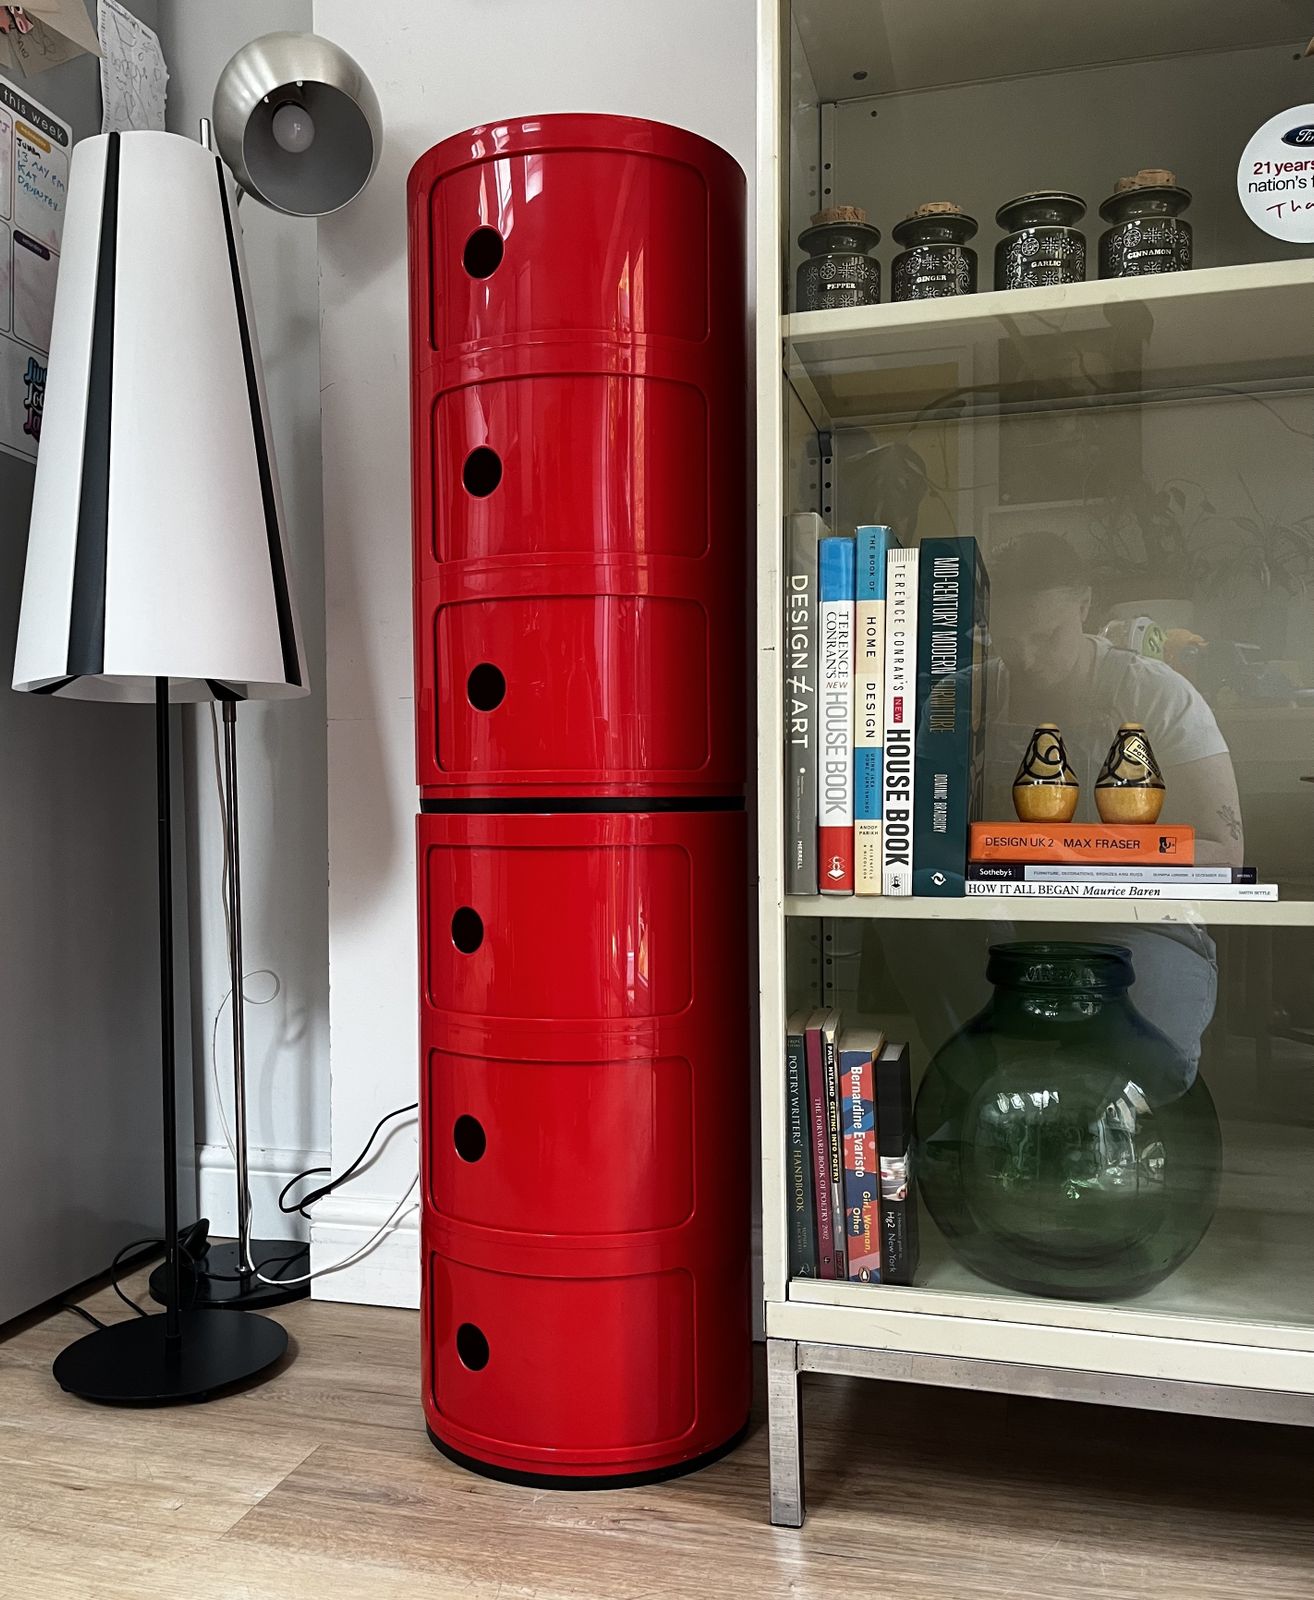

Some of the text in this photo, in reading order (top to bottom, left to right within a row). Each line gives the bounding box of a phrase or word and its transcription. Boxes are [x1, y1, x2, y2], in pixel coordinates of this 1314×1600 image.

[3, 90, 26, 114] this
[32, 112, 62, 140] week
[1248, 175, 1307, 193] nation's
[1253, 161, 1271, 175] 21
[1266, 200, 1314, 218] Tha
[917, 274, 947, 283] GINGER
[1127, 249, 1172, 259] CINNAMON
[869, 582, 875, 592] OF
[894, 565, 905, 623] TERENCE
[791, 575, 808, 669] DESIGN
[826, 611, 837, 679] CONRAN'S
[838, 611, 849, 678] TERENCE
[930, 557, 960, 733] MID-CENTURY MODERN FURNITURE
[866, 616, 876, 738] HOME DESIGN
[893, 632, 904, 691] CONRAN'S
[791, 699, 808, 748] ART
[894, 699, 902, 721] NEW
[825, 692, 848, 815] HOUSE BOOK
[885, 729, 911, 801] HOUSE
[933, 774, 948, 833] DOMINIC BRADBURY
[885, 809, 909, 866] BOOK
[985, 837, 1140, 849] DESIGN UK 2 MAX FRASER
[968, 884, 997, 894] HOW
[1000, 884, 1012, 894] IT
[1013, 884, 1035, 894] ALL
[1038, 885, 1079, 895] BEGAN
[1082, 885, 1126, 896] Maurice
[1129, 886, 1161, 896] Baren
[979, 868, 1012, 878] Sotheby's
[788, 1055, 799, 1093] POETRY
[791, 1094, 803, 1147] WRITERS'
[850, 1066, 867, 1178] Bernardine Evaristo
[820, 1192, 828, 1222] POETRY
[852, 1207, 861, 1235] Other
[862, 1190, 872, 1253] Girl, Woman,
[888, 1232, 896, 1253] New
[888, 1253, 896, 1273] York
